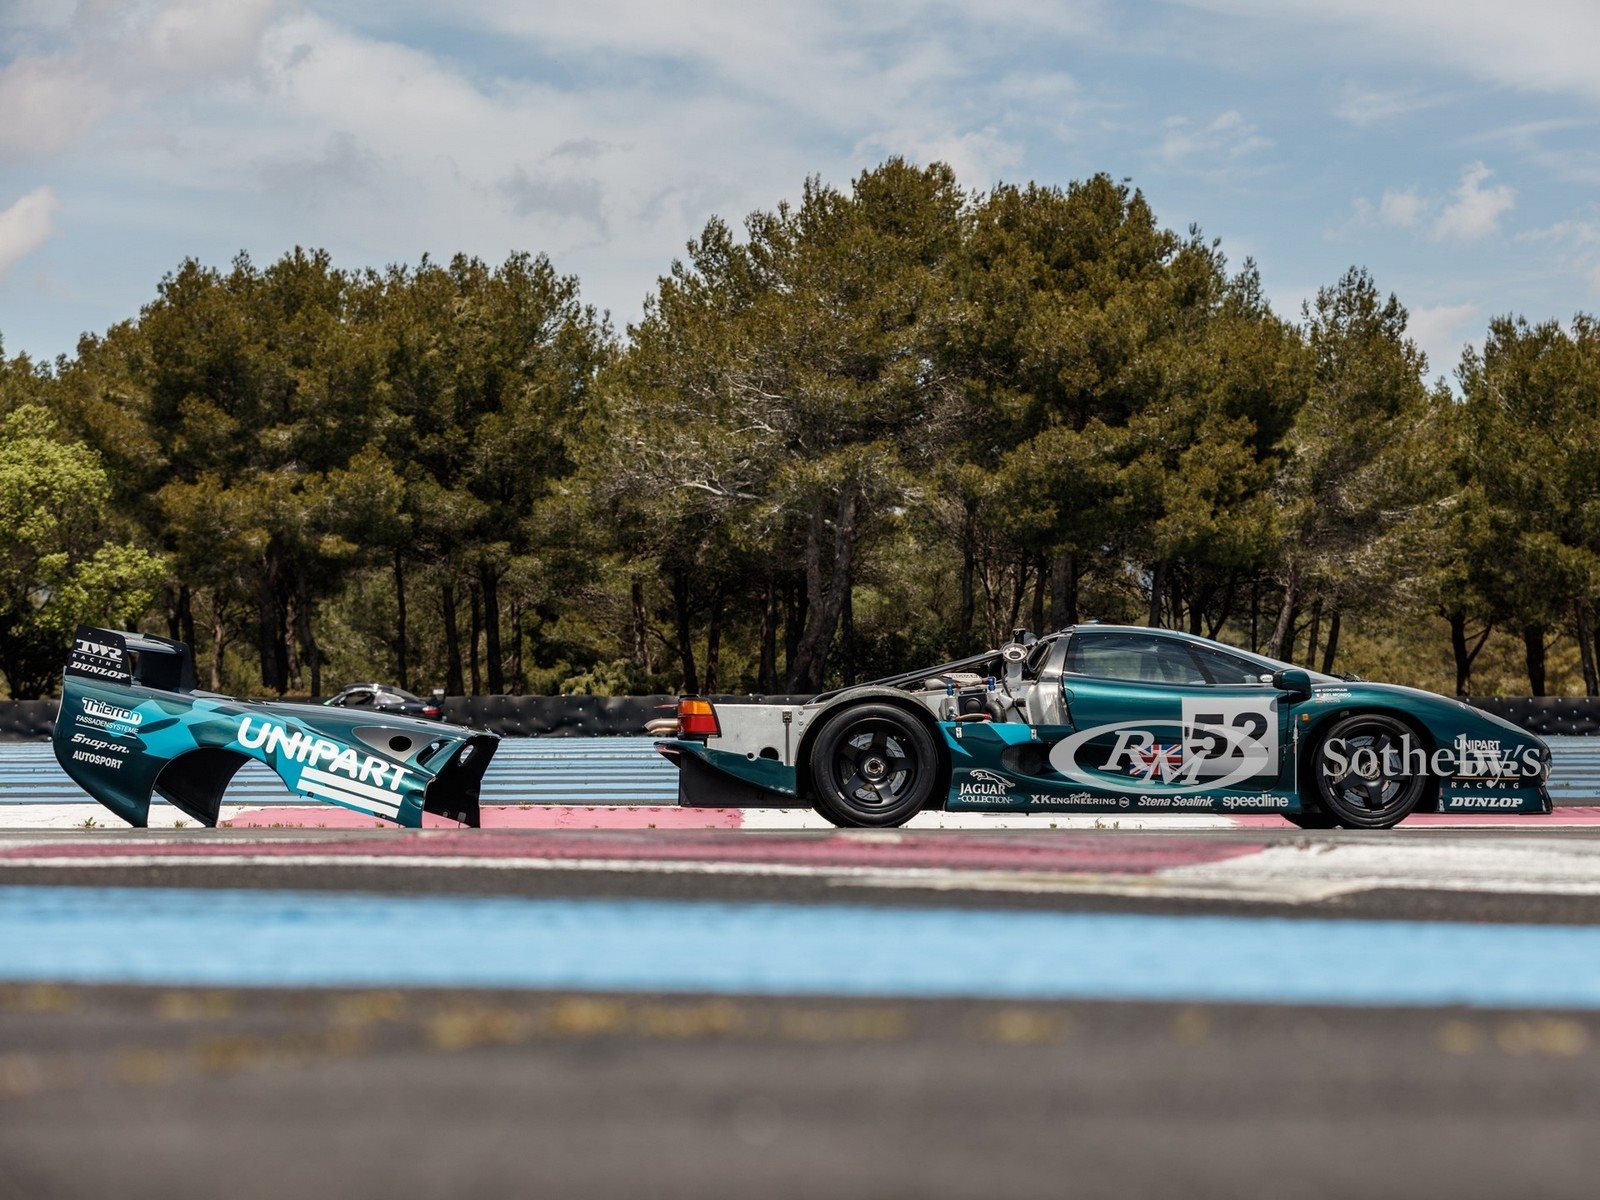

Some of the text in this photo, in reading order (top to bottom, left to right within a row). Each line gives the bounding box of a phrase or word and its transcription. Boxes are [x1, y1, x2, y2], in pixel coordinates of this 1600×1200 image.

[76, 639, 123, 662] TWR
[72, 652, 121, 668] RACING
[70, 661, 129, 680] DUNLOP
[76, 714, 139, 735] FASSADENSYSTEME
[1190, 712, 1269, 759] 52
[1454, 739, 1501, 751] UNIPART
[72, 750, 123, 770] AUTOSPORT
[237, 717, 413, 791] UNIPART
[959, 783, 1006, 796] JAGUAR
[1138, 796, 1170, 807] Stena
[1171, 796, 1214, 807] Sealink
[1222, 794, 1289, 810] speedline
[1449, 797, 1524, 808] DUNLOP
